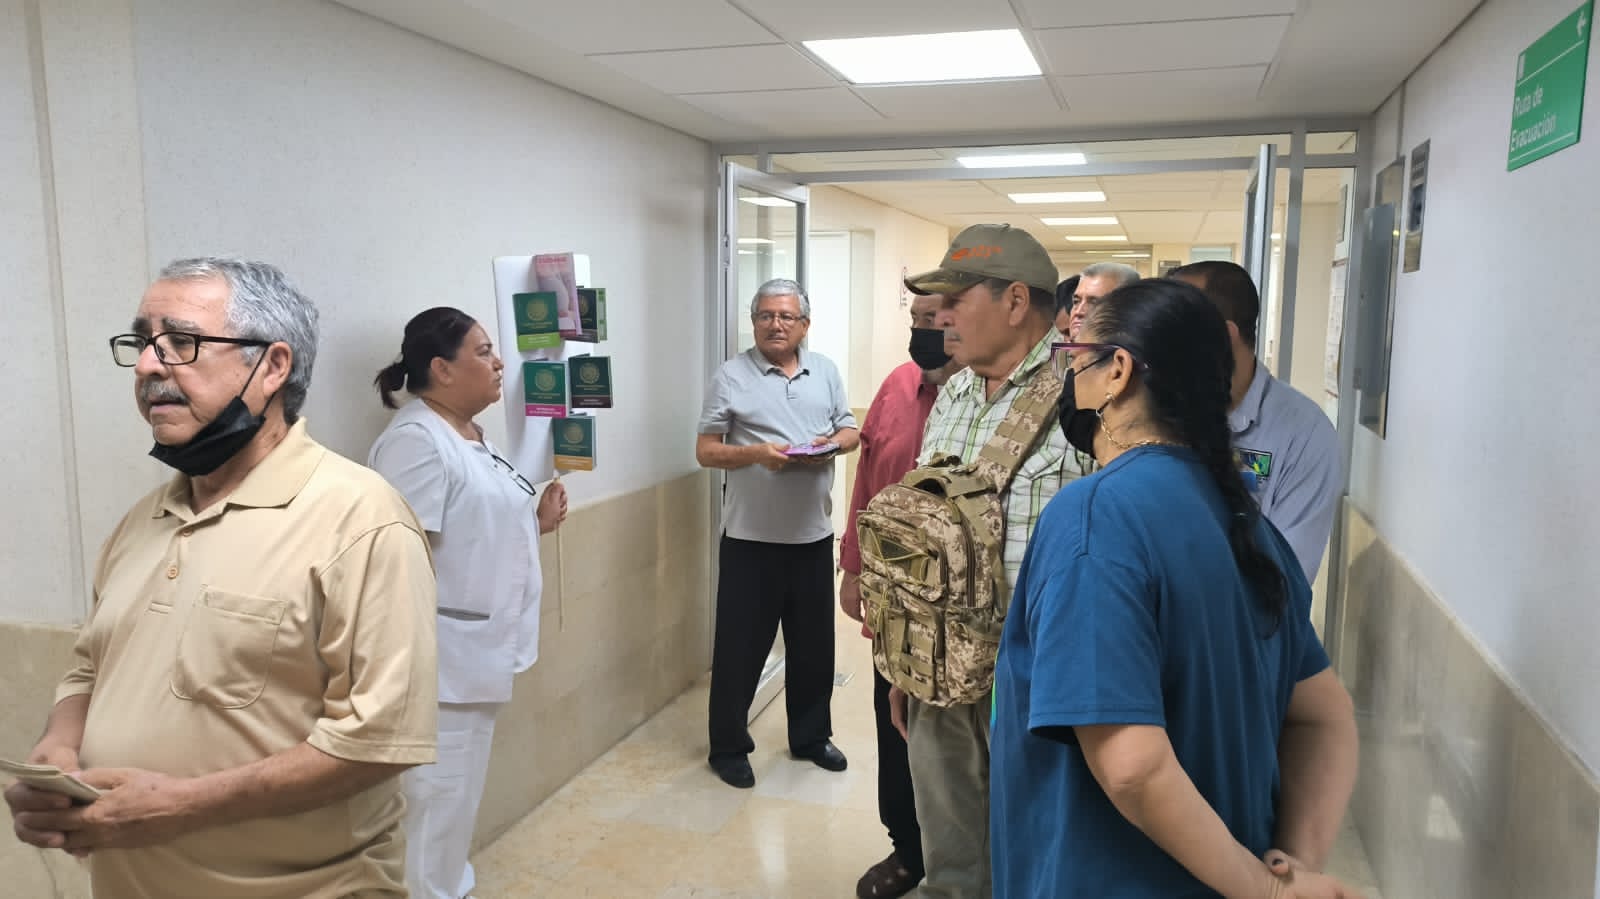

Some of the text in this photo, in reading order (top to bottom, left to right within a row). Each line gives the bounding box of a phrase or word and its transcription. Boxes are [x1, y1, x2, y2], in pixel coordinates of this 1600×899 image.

[1514, 84, 1543, 119] Ruta de
[1511, 111, 1557, 152] Evacuación
